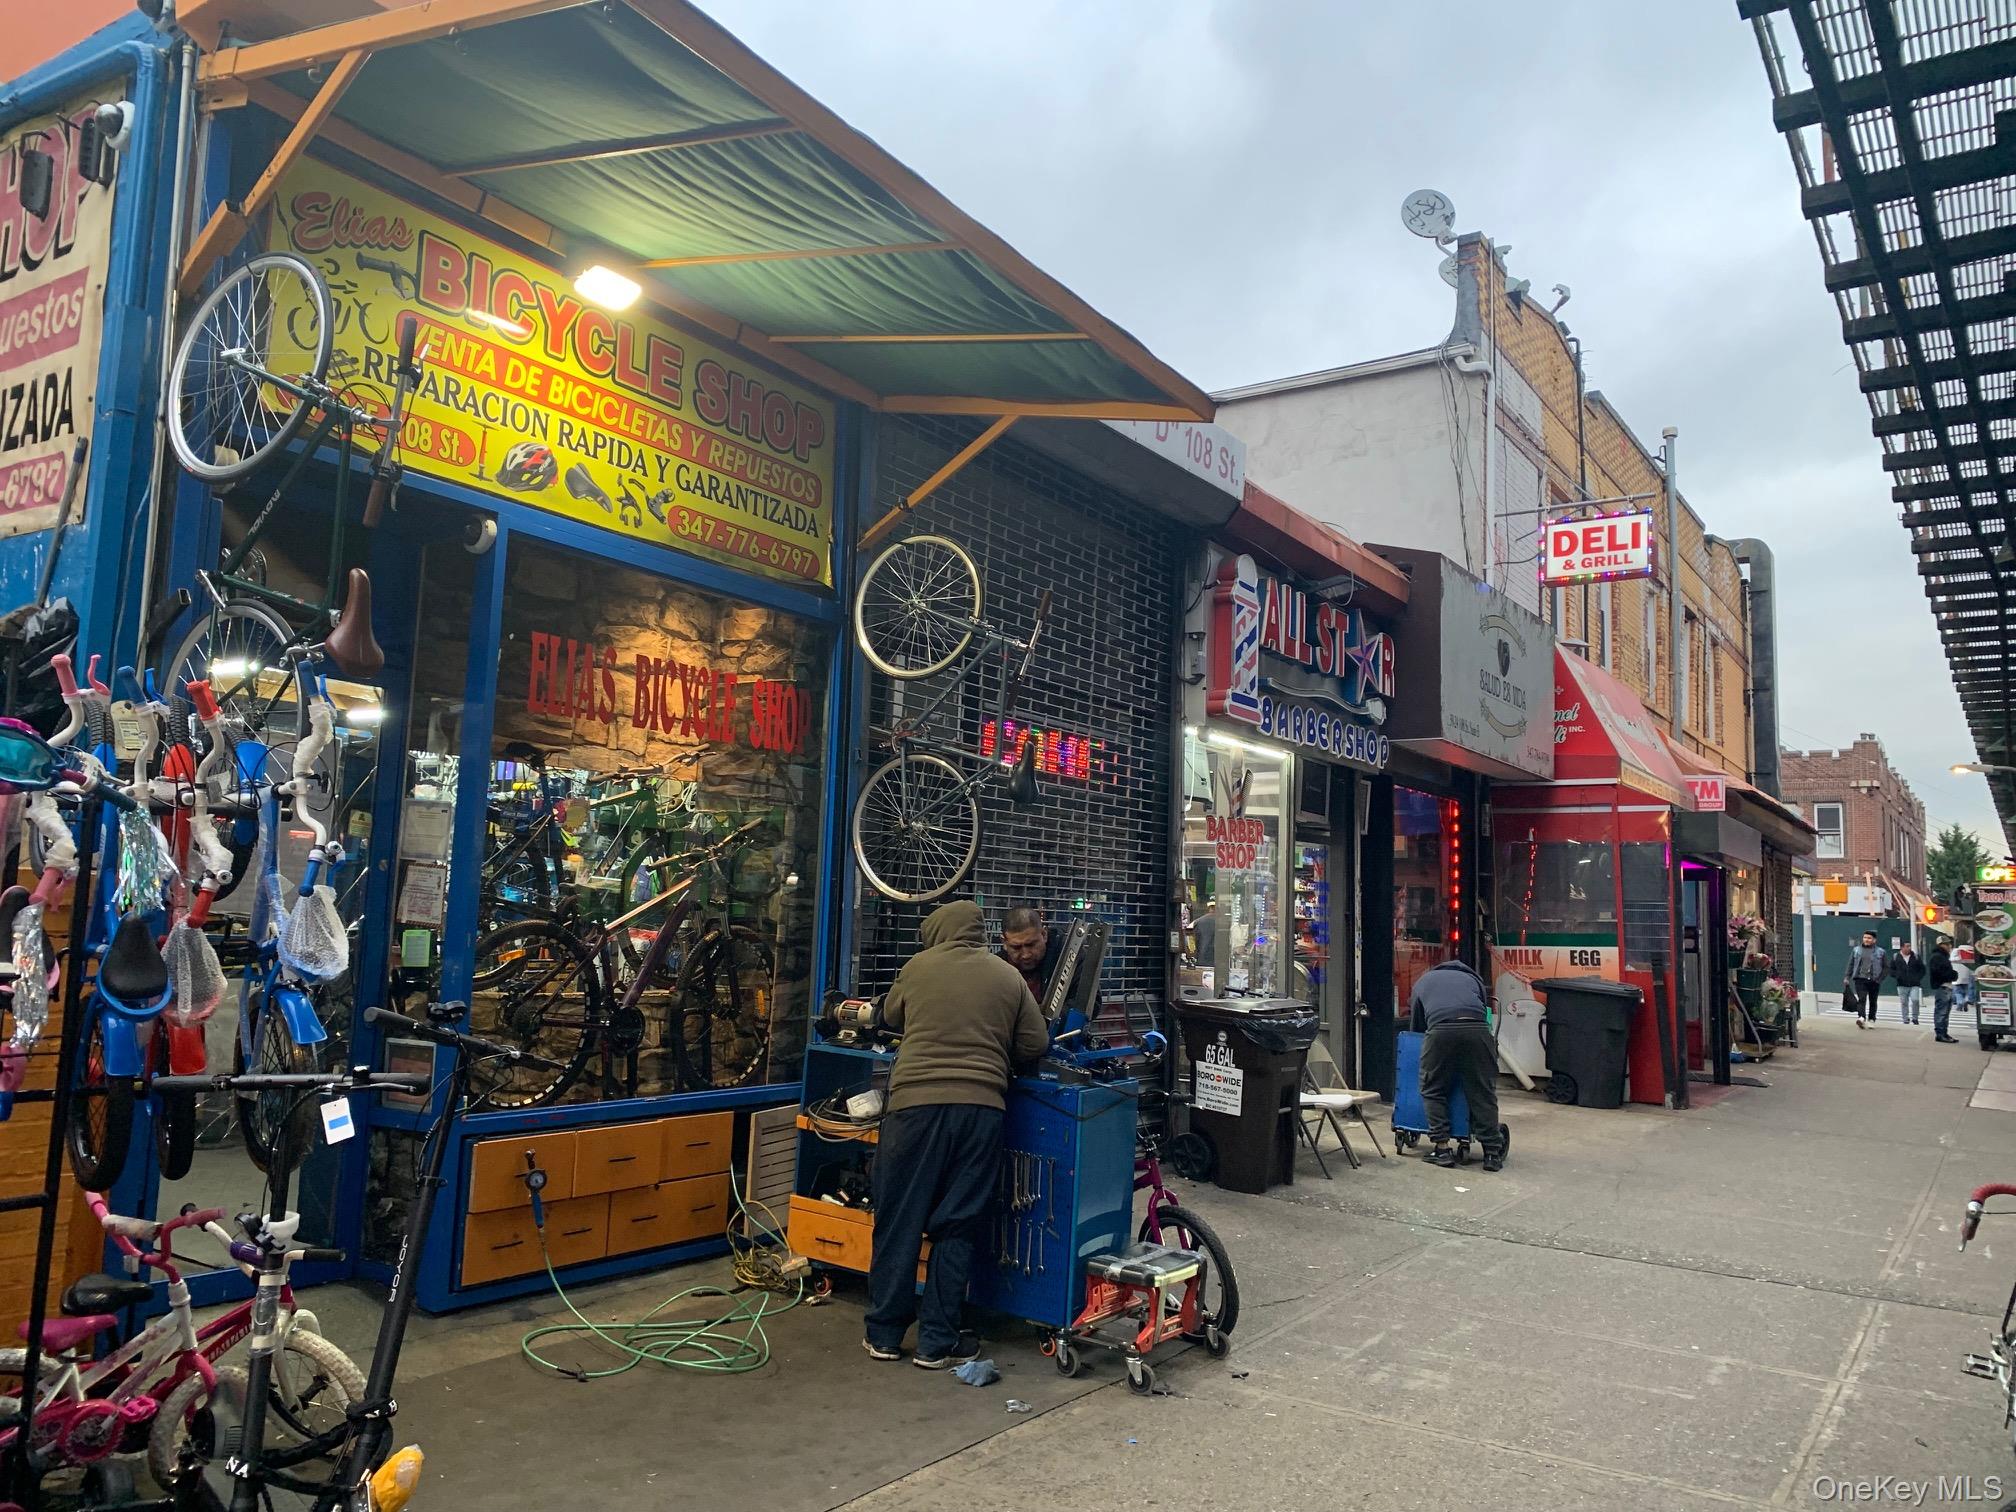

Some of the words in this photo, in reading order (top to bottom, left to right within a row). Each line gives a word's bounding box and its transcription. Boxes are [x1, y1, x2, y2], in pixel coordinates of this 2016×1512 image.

[292, 192, 414, 252] Elias
[417, 230, 685, 408] BICYCLE
[695, 359, 825, 462] SHOP
[362, 345, 550, 442] REARACION
[557, 418, 648, 478] RAPIDA
[655, 454, 670, 483] Y
[675, 464, 819, 538] GARANTIZADA
[402, 412, 432, 453] 08
[438, 428, 464, 464] St.
[504, 357, 543, 397] DE
[548, 374, 683, 451] BICICLETAS
[690, 430, 705, 457] Y
[708, 438, 816, 502] REPUESTOS
[1185, 427, 1213, 469] 108
[1218, 446, 1239, 487] St.
[677, 510, 813, 574] 347-776-6797
[1553, 522, 1641, 557] DELI
[1562, 559, 1575, 570] &
[1581, 553, 1633, 569] GRILL
[1260, 577, 1312, 665] ALL
[527, 631, 617, 725] ELIAS
[632, 653, 738, 744] BICYCLE
[750, 678, 812, 755] SHOP
[1480, 668, 1500, 698] SALUD
[1503, 680, 1511, 703] ES
[1258, 696, 1390, 769] BARBERSHOP
[1206, 815, 1264, 845] BARBER
[1216, 843, 1256, 869] SHOP
[1977, 890, 2003, 902] Tacos
[1504, 949, 1543, 966] MILK
[1570, 949, 1600, 967] EGG
[1205, 1044, 1215, 1063] 65
[1217, 1046, 1235, 1068] GAL
[1222, 1076, 1242, 1087] WIDE
